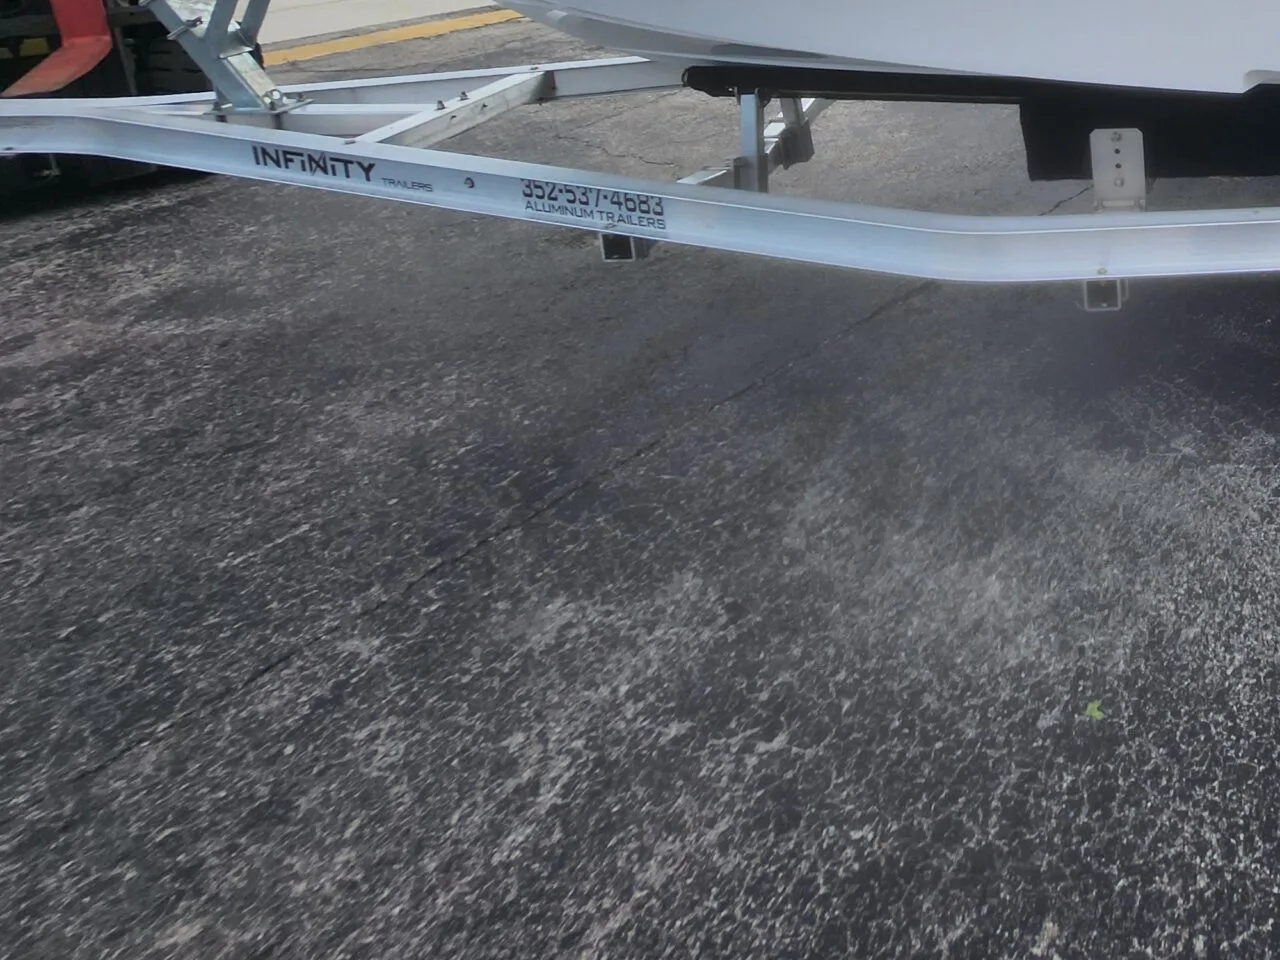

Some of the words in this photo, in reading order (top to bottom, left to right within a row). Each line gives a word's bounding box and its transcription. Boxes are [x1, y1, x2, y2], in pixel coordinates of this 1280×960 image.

[381, 177, 433, 192] TRAILERS
[525, 200, 594, 219] ALUMINUM
[596, 210, 666, 230] TRAILERS
